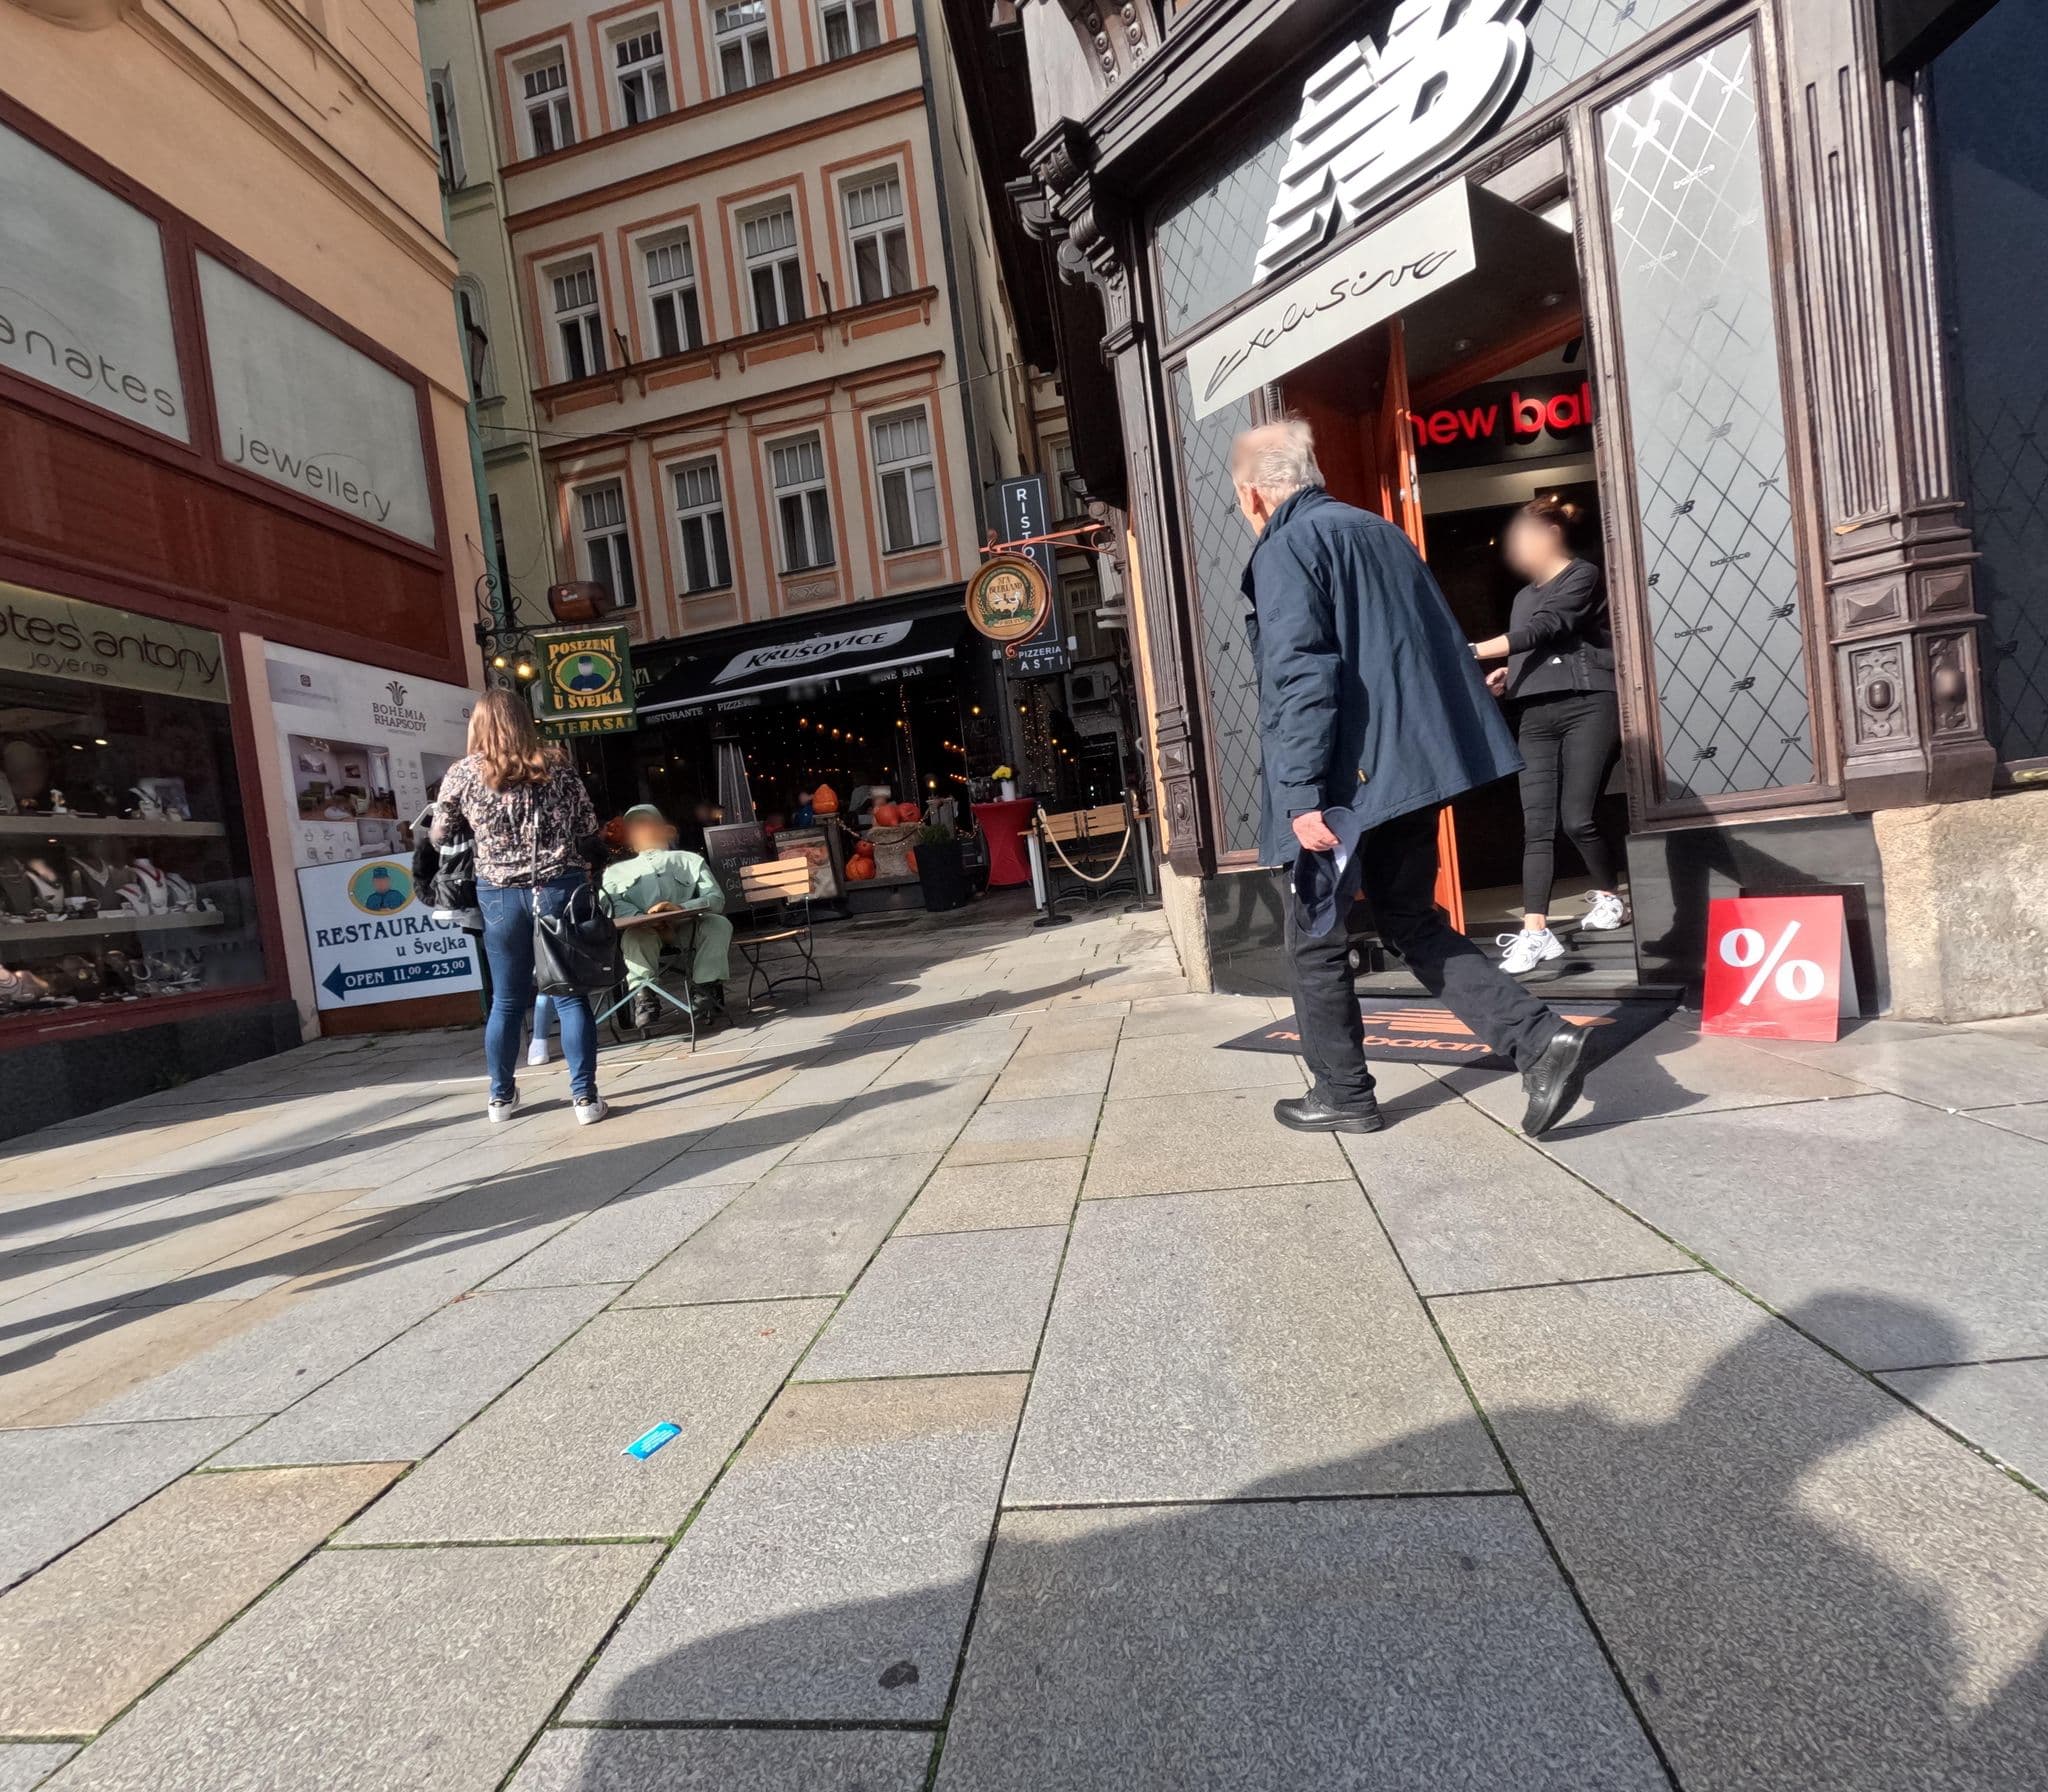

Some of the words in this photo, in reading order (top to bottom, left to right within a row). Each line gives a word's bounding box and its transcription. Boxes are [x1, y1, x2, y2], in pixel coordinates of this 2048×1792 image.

[235, 427, 391, 523] jewellery
[92, 630, 221, 684] antony
[1018, 646, 1062, 659] PIZZERIA
[1020, 656, 1064, 671] ASTI
[554, 694, 564, 710] U
[371, 702, 426, 722] BOHEMIA
[374, 713, 427, 732] RHAPSODY
[556, 716, 625, 735] TERASA
[396, 945, 407, 957] u
[414, 936, 468, 956] Švejka
[344, 970, 385, 988] OPEN
[1362, 1033, 1494, 1054] balan
